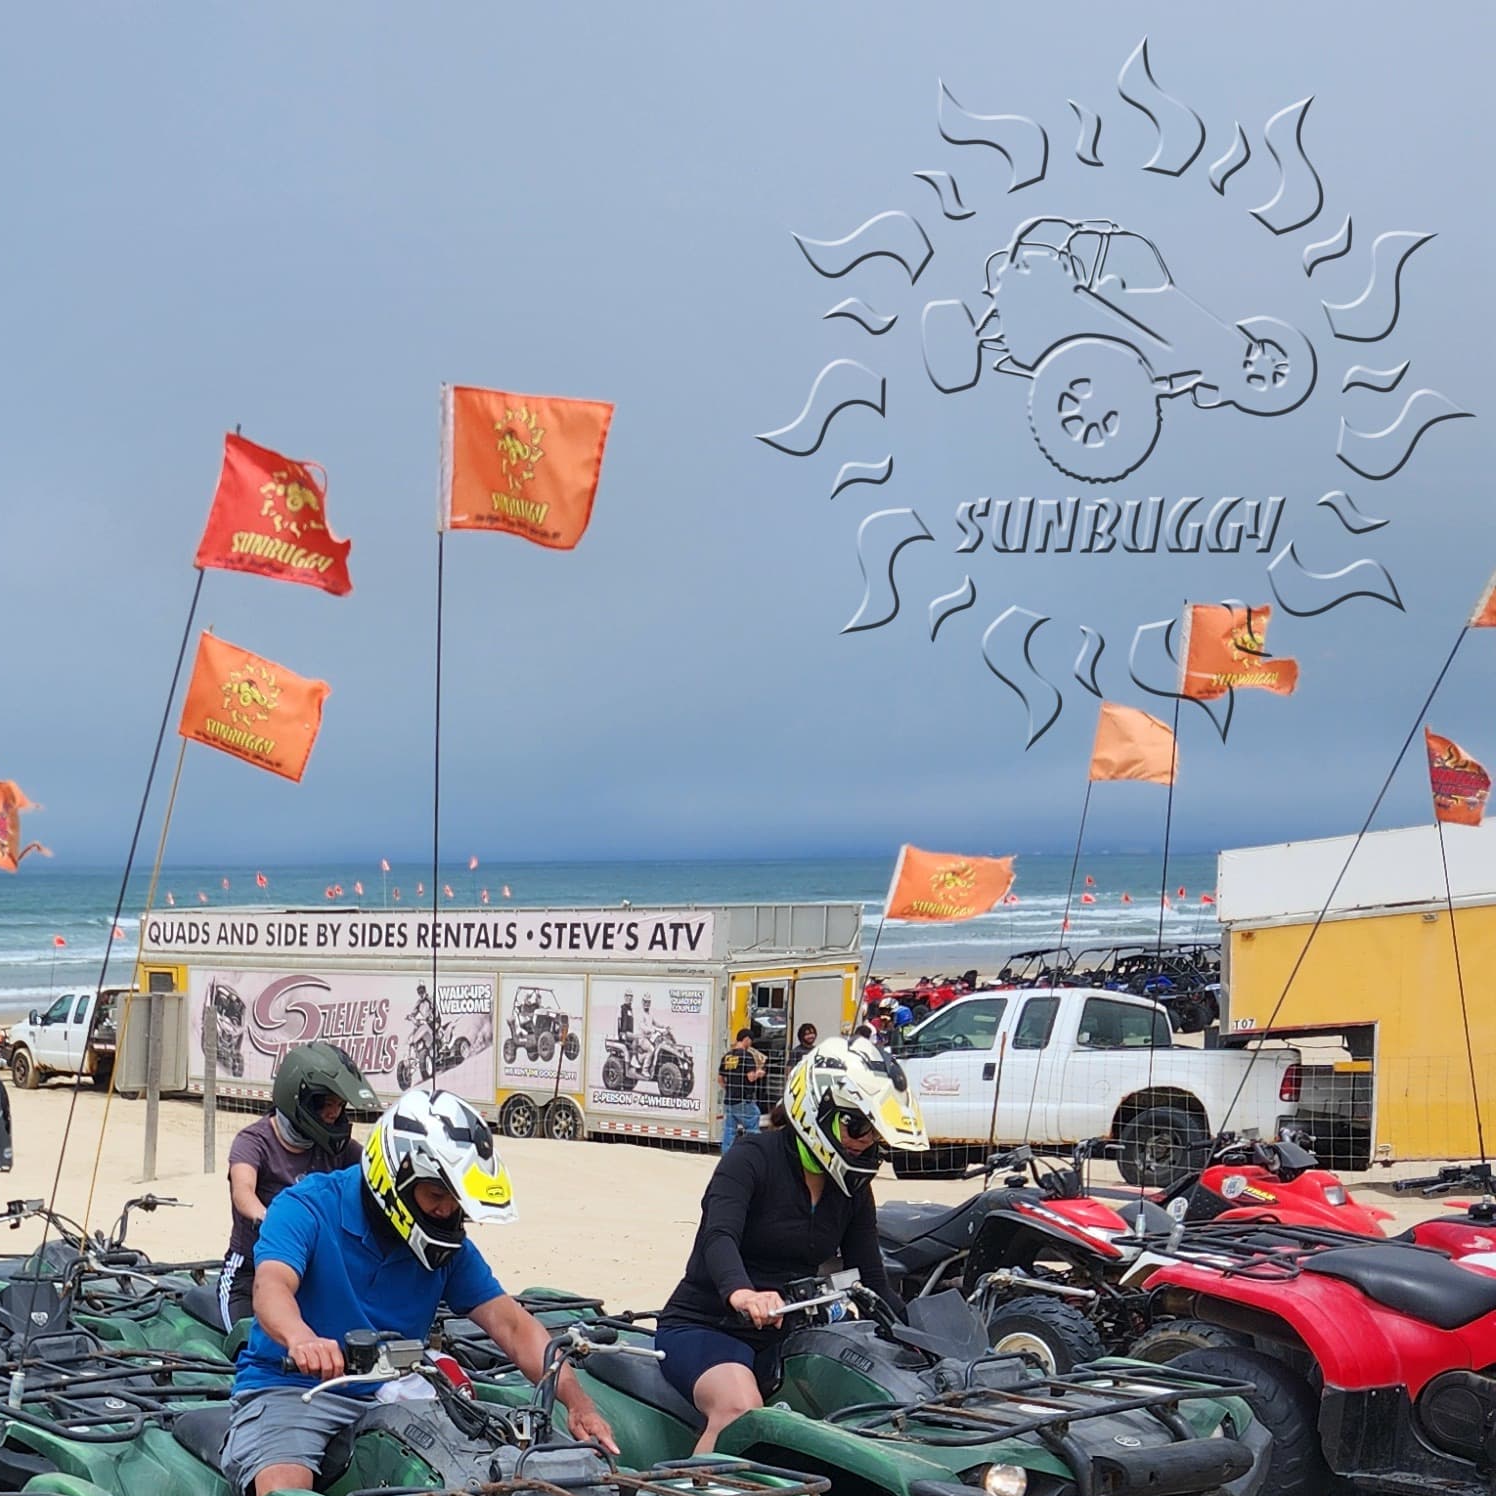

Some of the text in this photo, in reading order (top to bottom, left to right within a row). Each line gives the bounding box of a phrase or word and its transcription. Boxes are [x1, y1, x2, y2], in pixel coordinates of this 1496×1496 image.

[231, 530, 334, 573] SUNBUGGY
[206, 717, 276, 755] SUNBUGGY
[148, 921, 705, 951] QUADS AND SIDE BY SIDES RENTALS STEVE'S ATV
[439, 999, 491, 1014] WELCOME
[676, 1098, 701, 1111] DRIVE
[842, 1349, 872, 1371] YAMAHA
